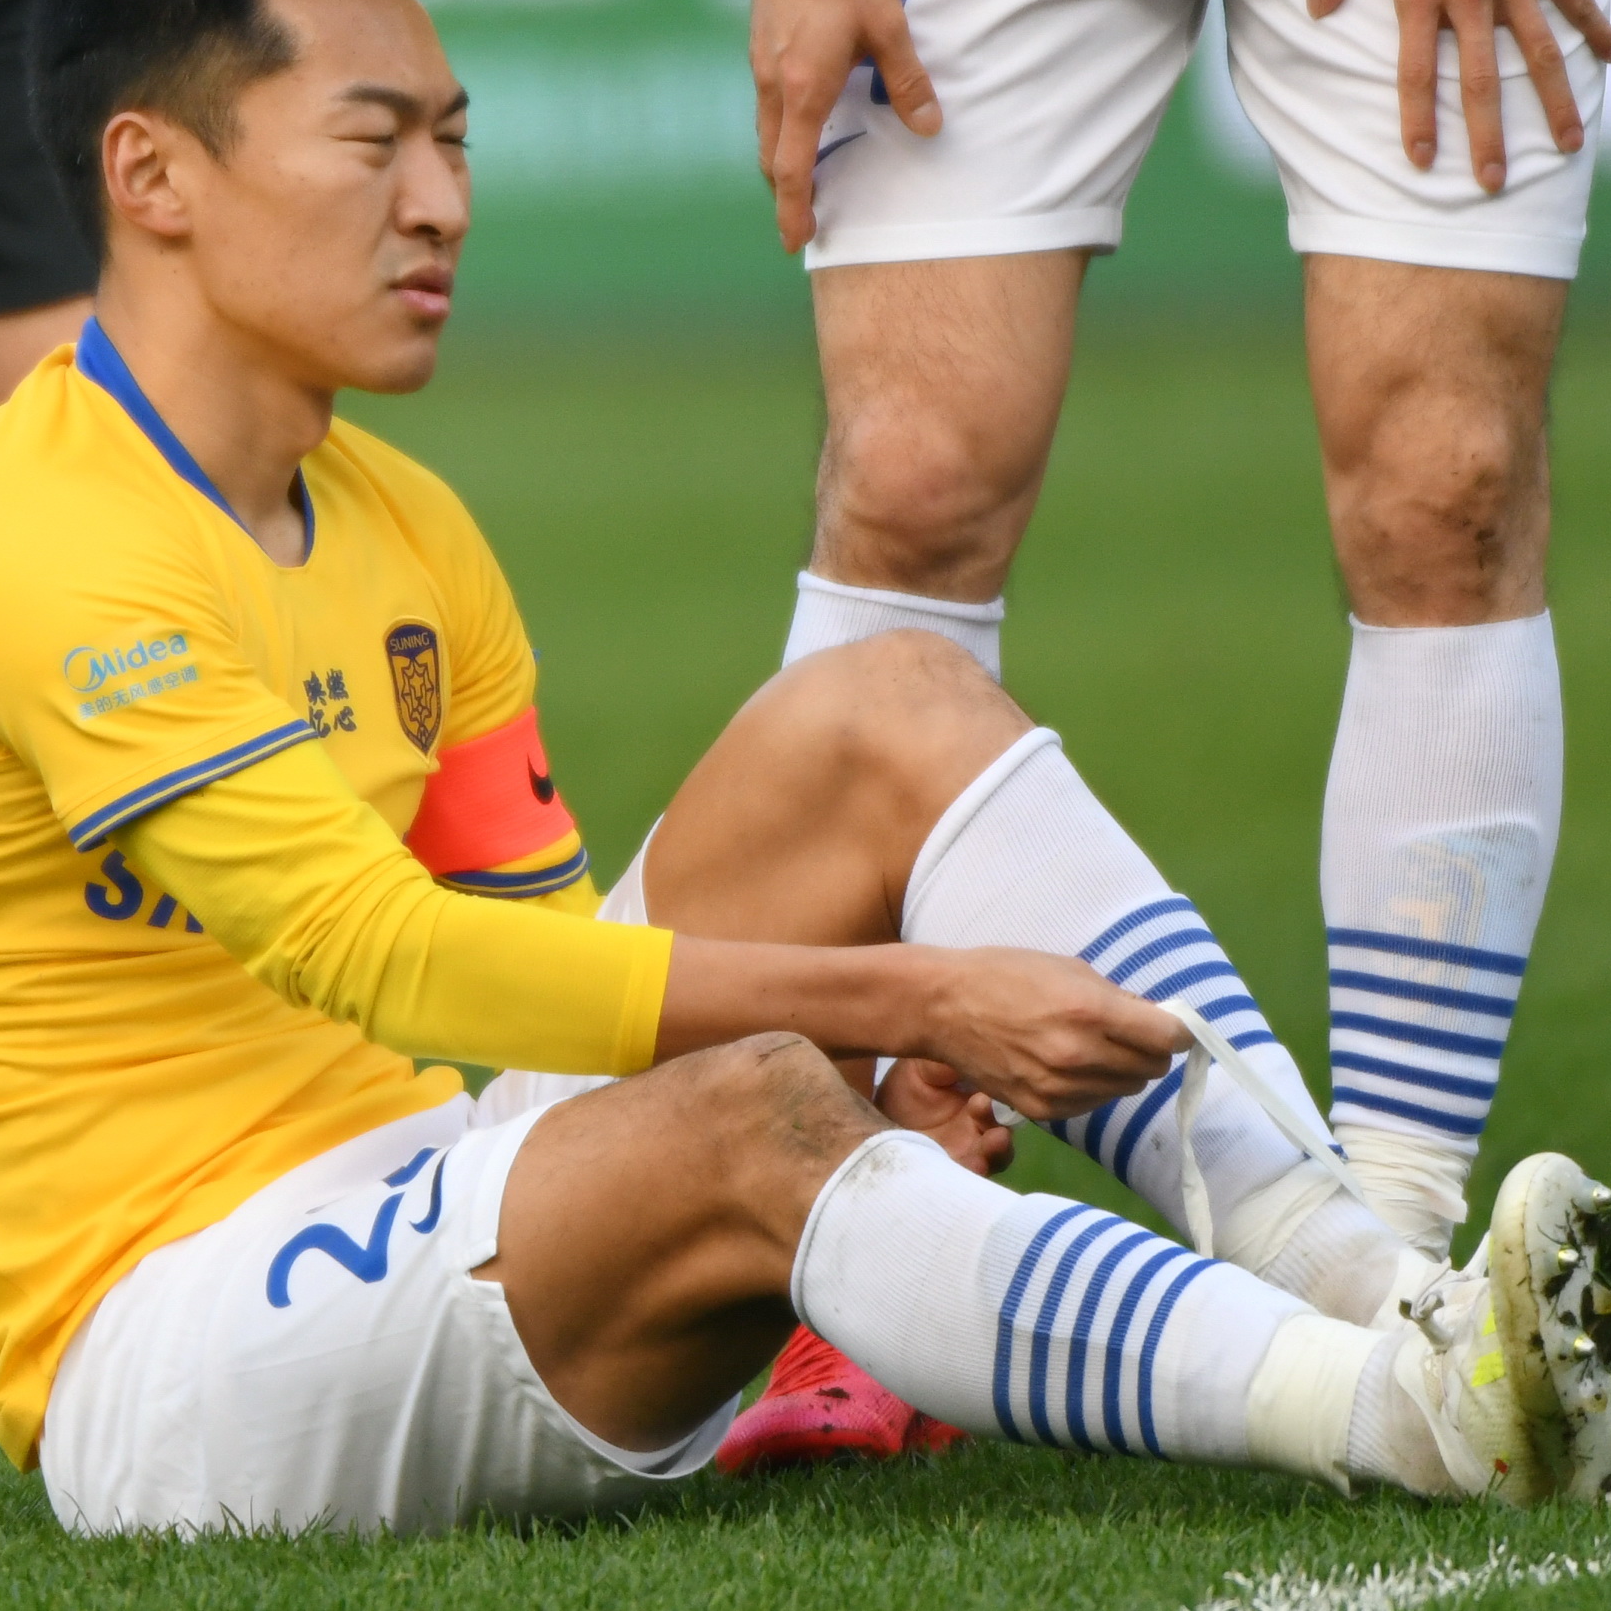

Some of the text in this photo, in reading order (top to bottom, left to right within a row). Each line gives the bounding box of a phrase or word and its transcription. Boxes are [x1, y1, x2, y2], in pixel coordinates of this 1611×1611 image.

[80, 634, 188, 686] Midea
[390, 632, 430, 653] SUNING
[79, 664, 199, 721] 美的无风感空调
